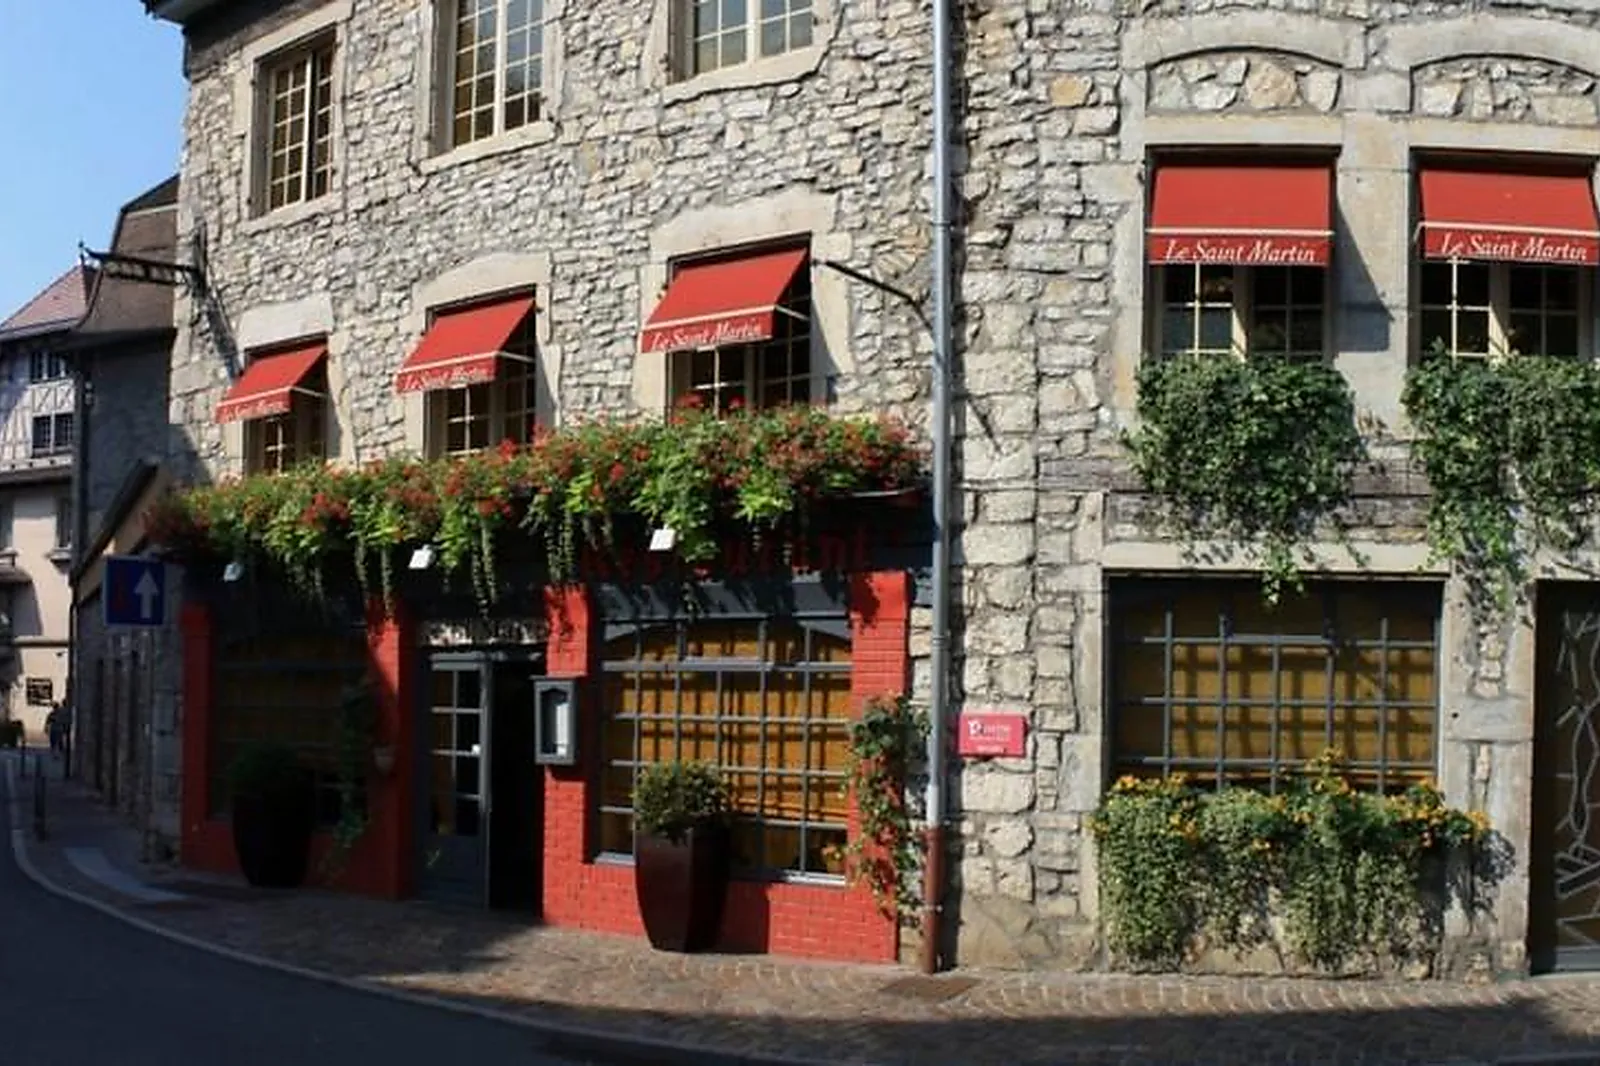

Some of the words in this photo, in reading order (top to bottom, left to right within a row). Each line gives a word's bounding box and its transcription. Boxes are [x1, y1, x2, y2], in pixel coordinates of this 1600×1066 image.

[1165, 238, 1190, 261] Le
[1193, 239, 1244, 261] Saint
[1247, 240, 1315, 263] Martin
[1441, 231, 1464, 255] Le
[1469, 233, 1518, 258] Saint
[1522, 236, 1588, 261] Martin
